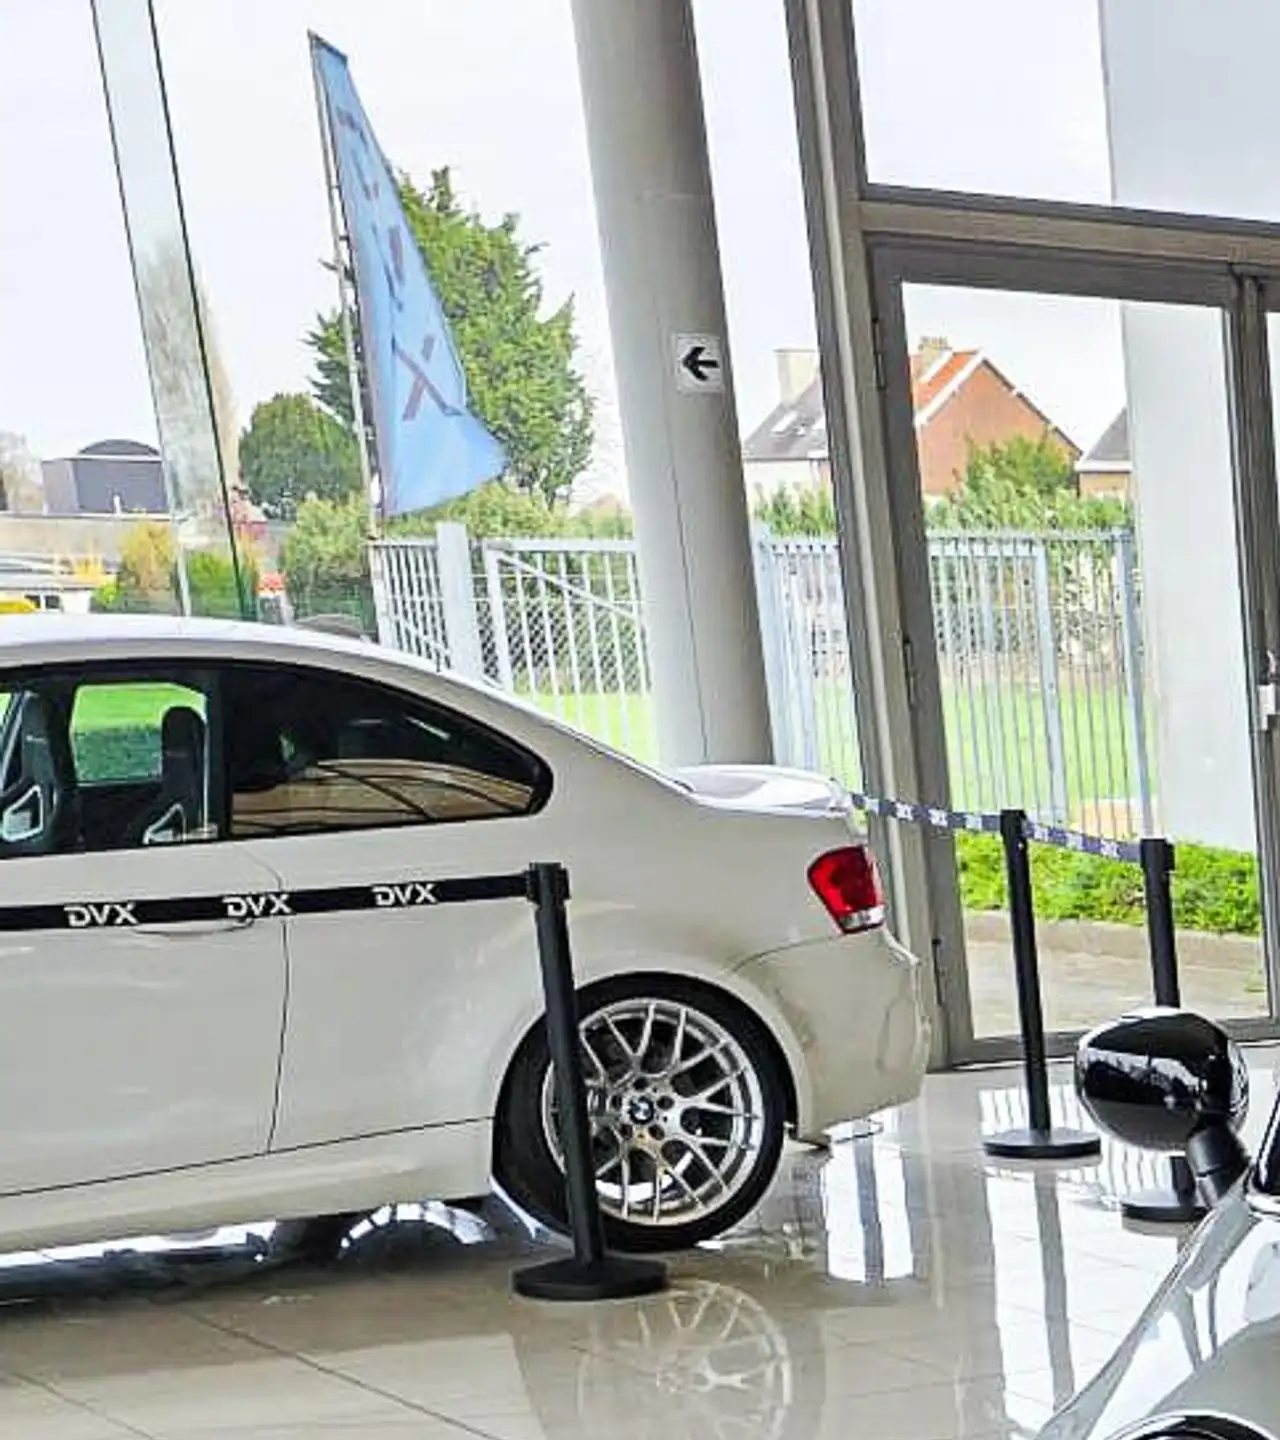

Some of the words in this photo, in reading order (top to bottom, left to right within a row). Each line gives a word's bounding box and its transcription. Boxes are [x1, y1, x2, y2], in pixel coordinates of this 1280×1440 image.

[222, 893, 296, 917] DVX
[372, 883, 437, 907] DVX
[63, 902, 139, 927] DVX
